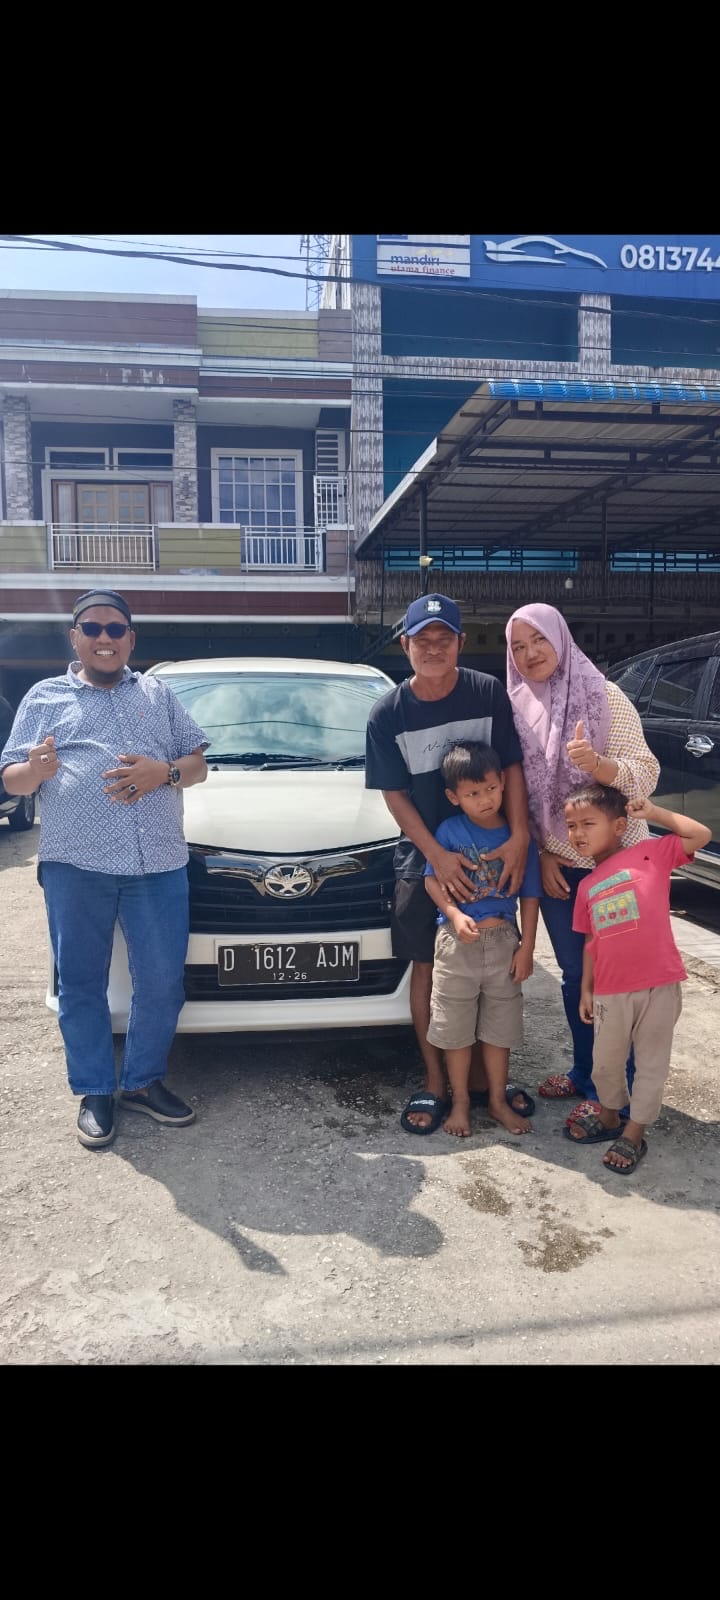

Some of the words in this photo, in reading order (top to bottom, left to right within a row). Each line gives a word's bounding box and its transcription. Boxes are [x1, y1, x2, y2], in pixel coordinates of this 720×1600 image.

[390, 254, 440, 266] mandiri
[390, 265, 420, 274] utama
[422, 265, 455, 275] finance
[223, 948, 235, 971] D
[254, 946, 296, 970] 1612
[316, 945, 354, 968] AJM
